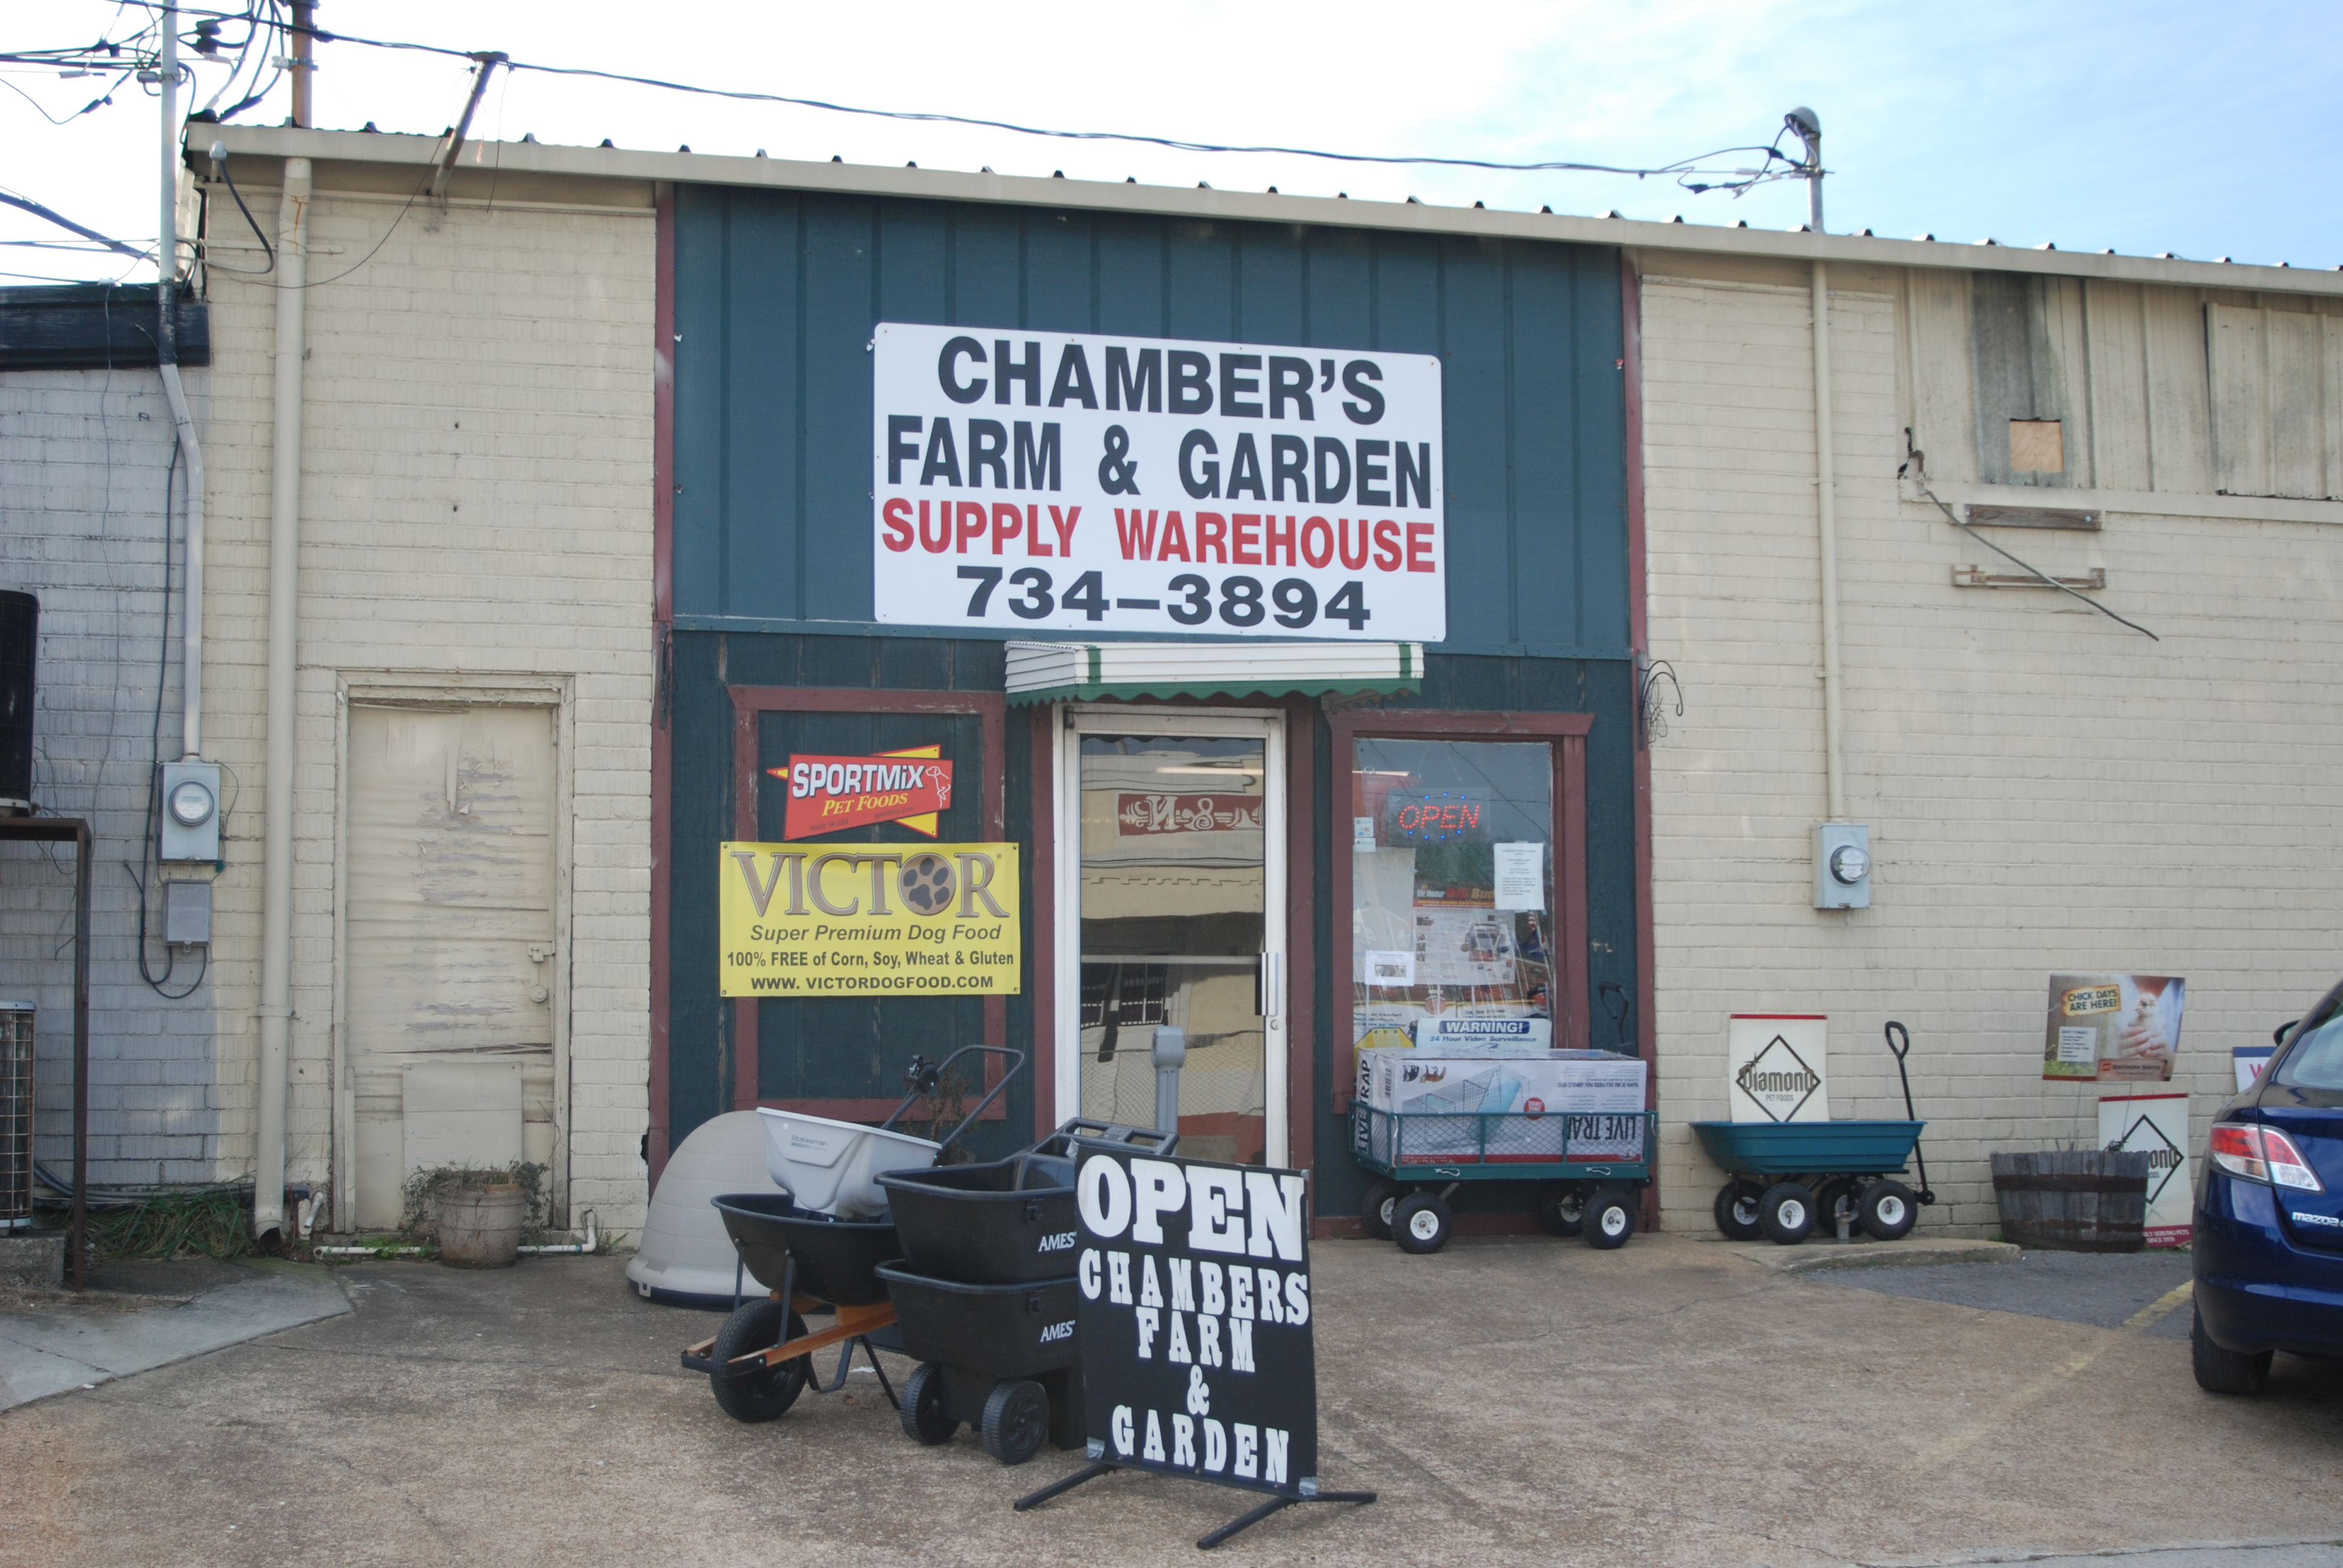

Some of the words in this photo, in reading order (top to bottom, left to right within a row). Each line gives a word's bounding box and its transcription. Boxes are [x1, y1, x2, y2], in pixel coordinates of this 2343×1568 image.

[938, 336, 1384, 425] CHAMBER'S
[888, 414, 1061, 491] FARM
[1098, 425, 1140, 495] &
[1178, 428, 1430, 508] GARDEN
[882, 497, 1082, 557] SUPPLY
[1114, 508, 1435, 573] WAREHOUSE
[957, 565, 1370, 630] 734-3894
[822, 799, 854, 817] PET
[856, 793, 908, 811] FOODS
[1399, 805, 1480, 829] OPEN
[810, 822, 827, 831] MADE
[730, 852, 1011, 917] VICTOR
[750, 925, 810, 944] Super
[814, 924, 902, 940] Premium
[908, 924, 946, 944] Dog
[952, 924, 1001, 940] Food
[727, 952, 766, 967] 100%
[771, 952, 808, 966] FREE
[813, 952, 827, 966] of
[831, 952, 868, 969] Corn,
[873, 951, 901, 969] Soy,
[905, 951, 949, 965] Wheat
[955, 950, 965, 964] &
[969, 950, 1014, 965] Gluten
[2068, 991, 2093, 1002] CHICK
[2096, 989, 2117, 998] DAYS
[2069, 1001, 2087, 1011] ARE
[2091, 999, 2117, 1009] HERE!
[1446, 1022, 1523, 1033] WARNING!
[1360, 1059, 1371, 1106] TRAP
[1738, 1063, 1814, 1093] Diamond
[791, 1134, 828, 1146] Statesman
[1357, 1111, 1369, 1152] LIVE
[1605, 1116, 1637, 1140] LIVE
[1077, 1155, 1304, 1261] OPEN
[1038, 1232, 1075, 1252] AMES
[1080, 1248, 1309, 1325] CHAMBERS
[1040, 1321, 1073, 1343] AMES
[1136, 1306, 1255, 1373] FARM
[1187, 1365, 1209, 1416] &
[1112, 1405, 1289, 1484] GARDEN
